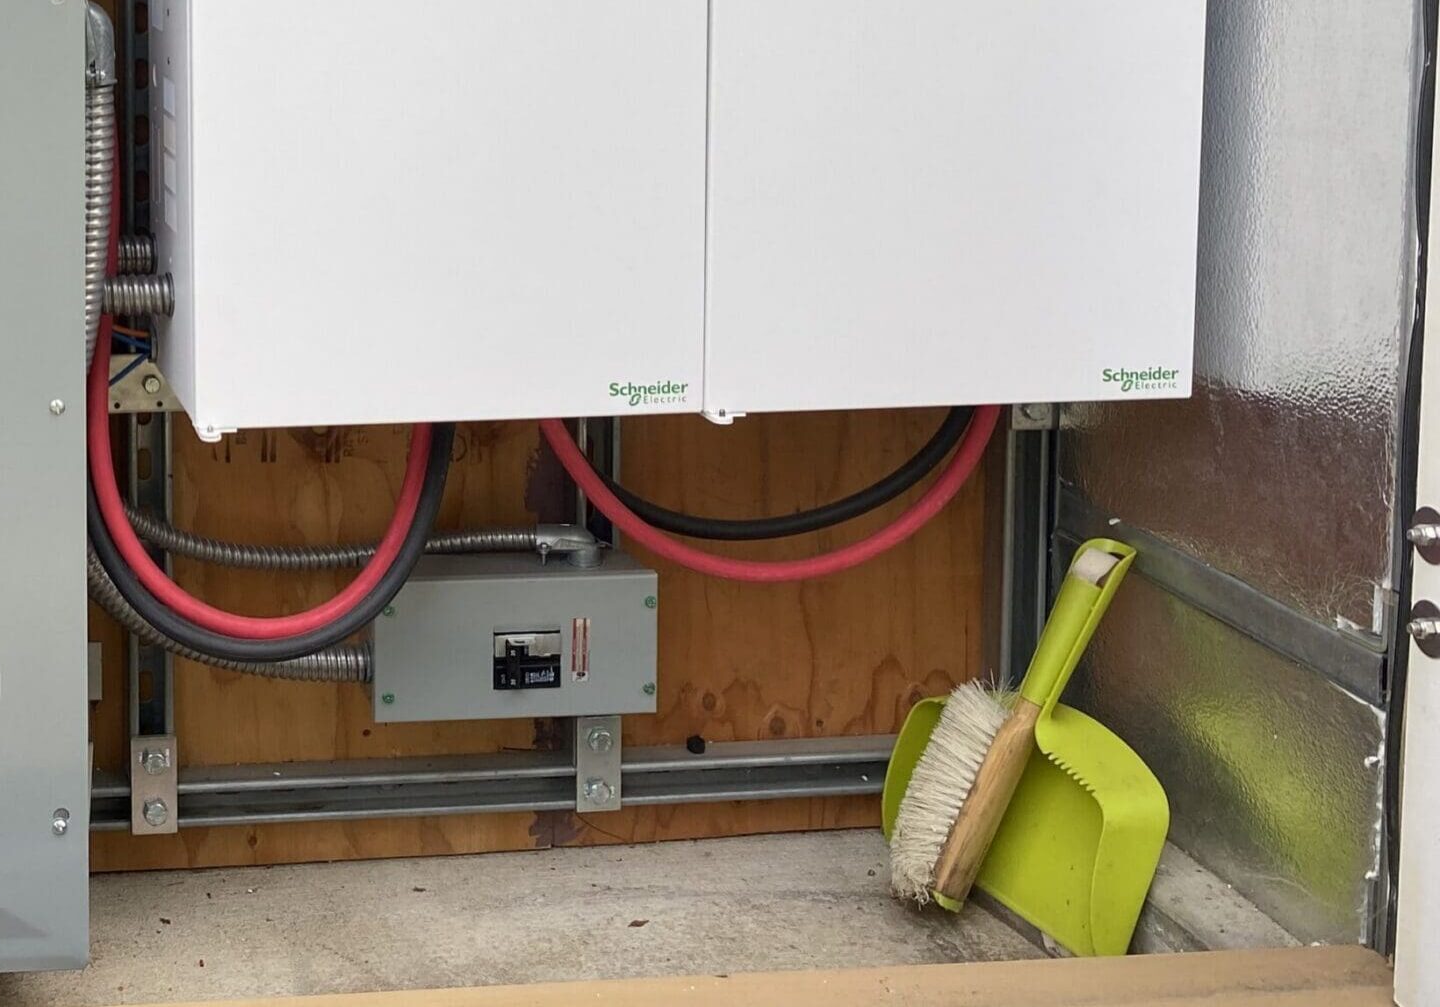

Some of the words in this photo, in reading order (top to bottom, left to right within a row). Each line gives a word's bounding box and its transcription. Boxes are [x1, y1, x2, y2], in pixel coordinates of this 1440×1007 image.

[1102, 365, 1179, 383] Schneider
[609, 380, 689, 397] Schneider
[1135, 382, 1177, 390] Electric
[643, 396, 687, 405] Electric
